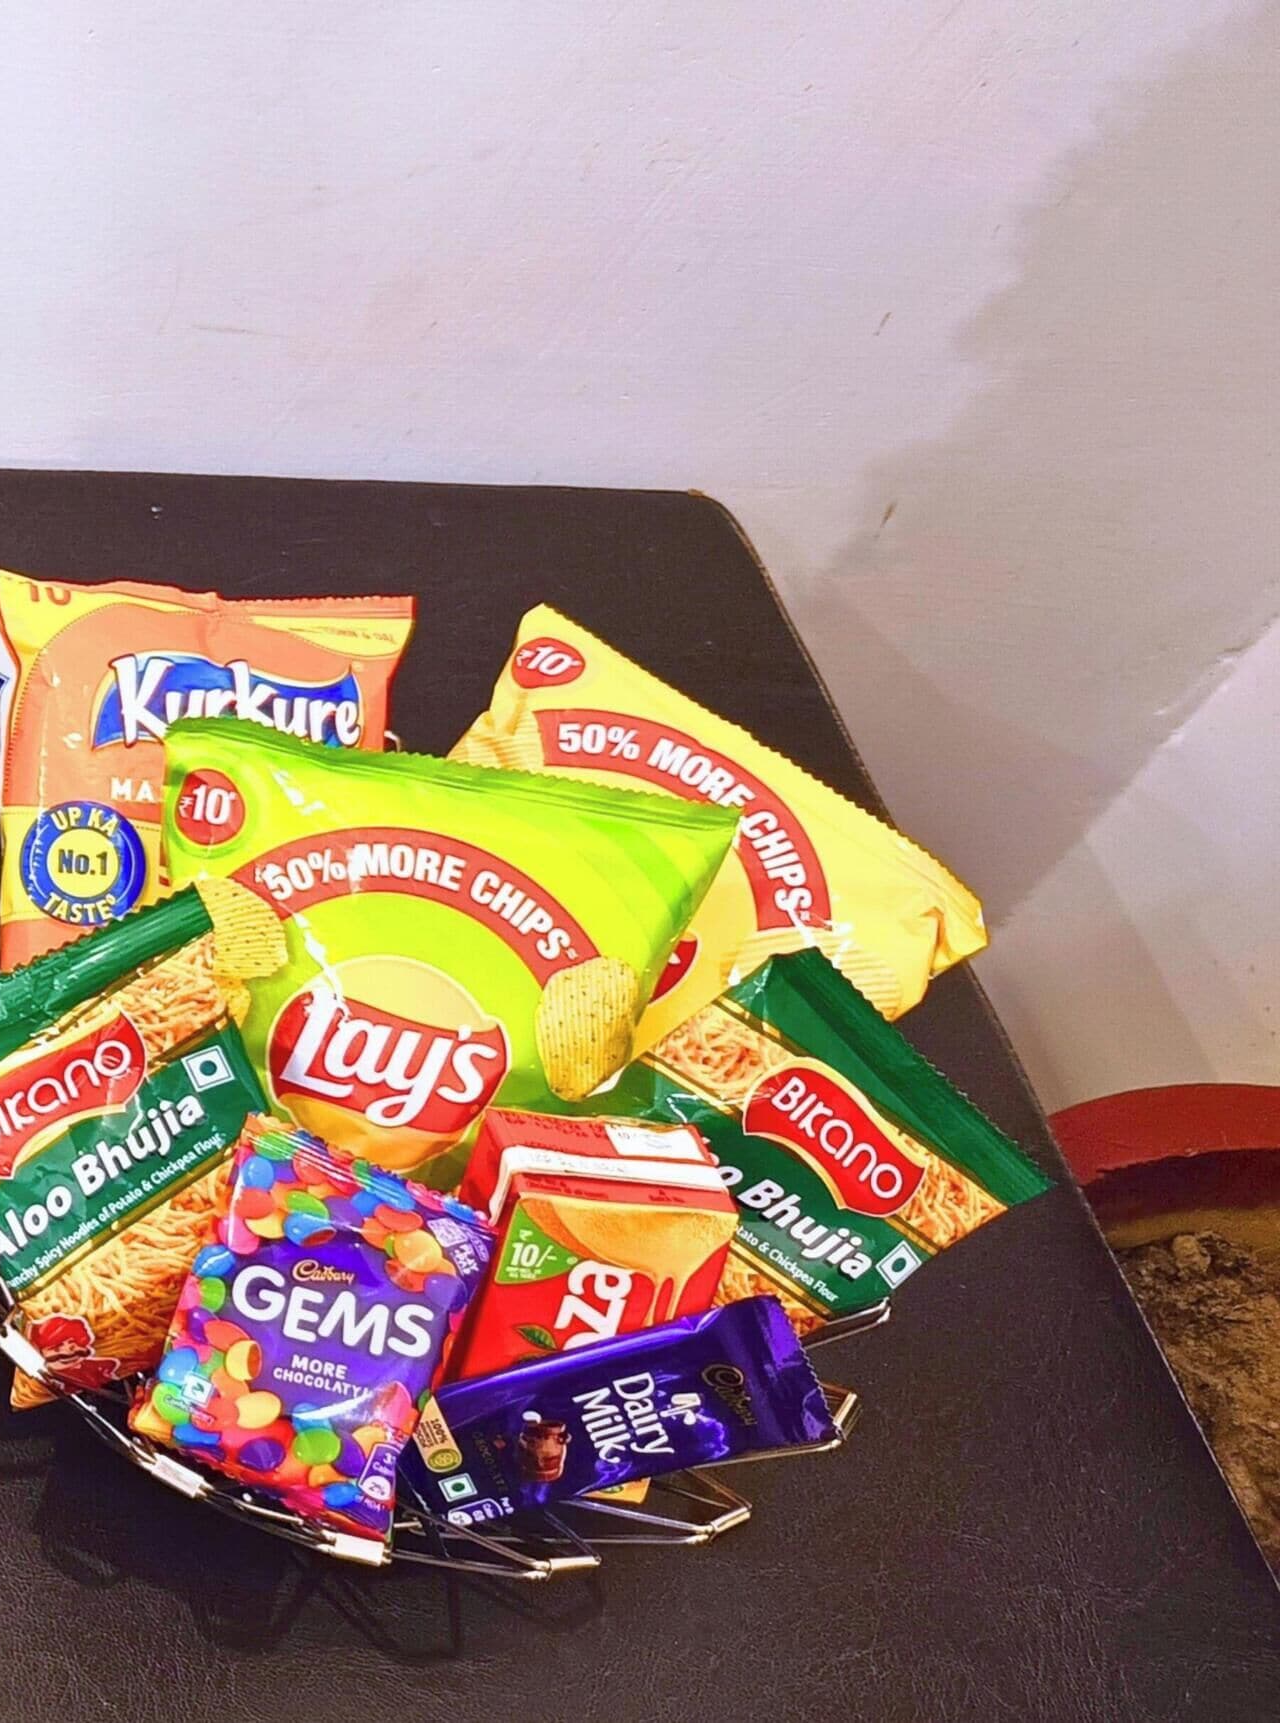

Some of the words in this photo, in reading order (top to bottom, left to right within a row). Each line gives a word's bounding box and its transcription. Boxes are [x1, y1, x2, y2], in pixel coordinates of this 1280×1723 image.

[109, 654, 361, 746] Kurkure
[558, 723, 640, 761] 50%
[647, 737, 755, 808] MORE
[50, 806, 82, 831] UP
[87, 807, 119, 838] KA
[58, 848, 108, 876] No.1
[262, 847, 346, 902] 50%
[350, 844, 467, 891] MORE
[43, 892, 112, 923] TASTE
[279, 986, 499, 1131] Lay's
[71, 1094, 205, 1197] Bhujia
[36, 1245, 64, 1270] Spicy
[62, 1217, 100, 1251] Noodles
[97, 1209, 111, 1223] of
[109, 1187, 144, 1218] Potato
[142, 1177, 153, 1192] &
[151, 1152, 197, 1186] Chickpea
[194, 1132, 224, 1157] Flour
[737, 1179, 873, 1281] Bhujia
[292, 1259, 355, 1285] Cadbury
[510, 1241, 558, 1267] 10/-
[758, 1241, 770, 1255] &
[769, 1248, 815, 1288] Chickpea
[813, 1279, 839, 1303] Flour
[232, 1265, 434, 1357] GEMS
[291, 1354, 349, 1380] MORE
[572, 1386, 630, 1464] Milk
[613, 1371, 675, 1455] Dairy
